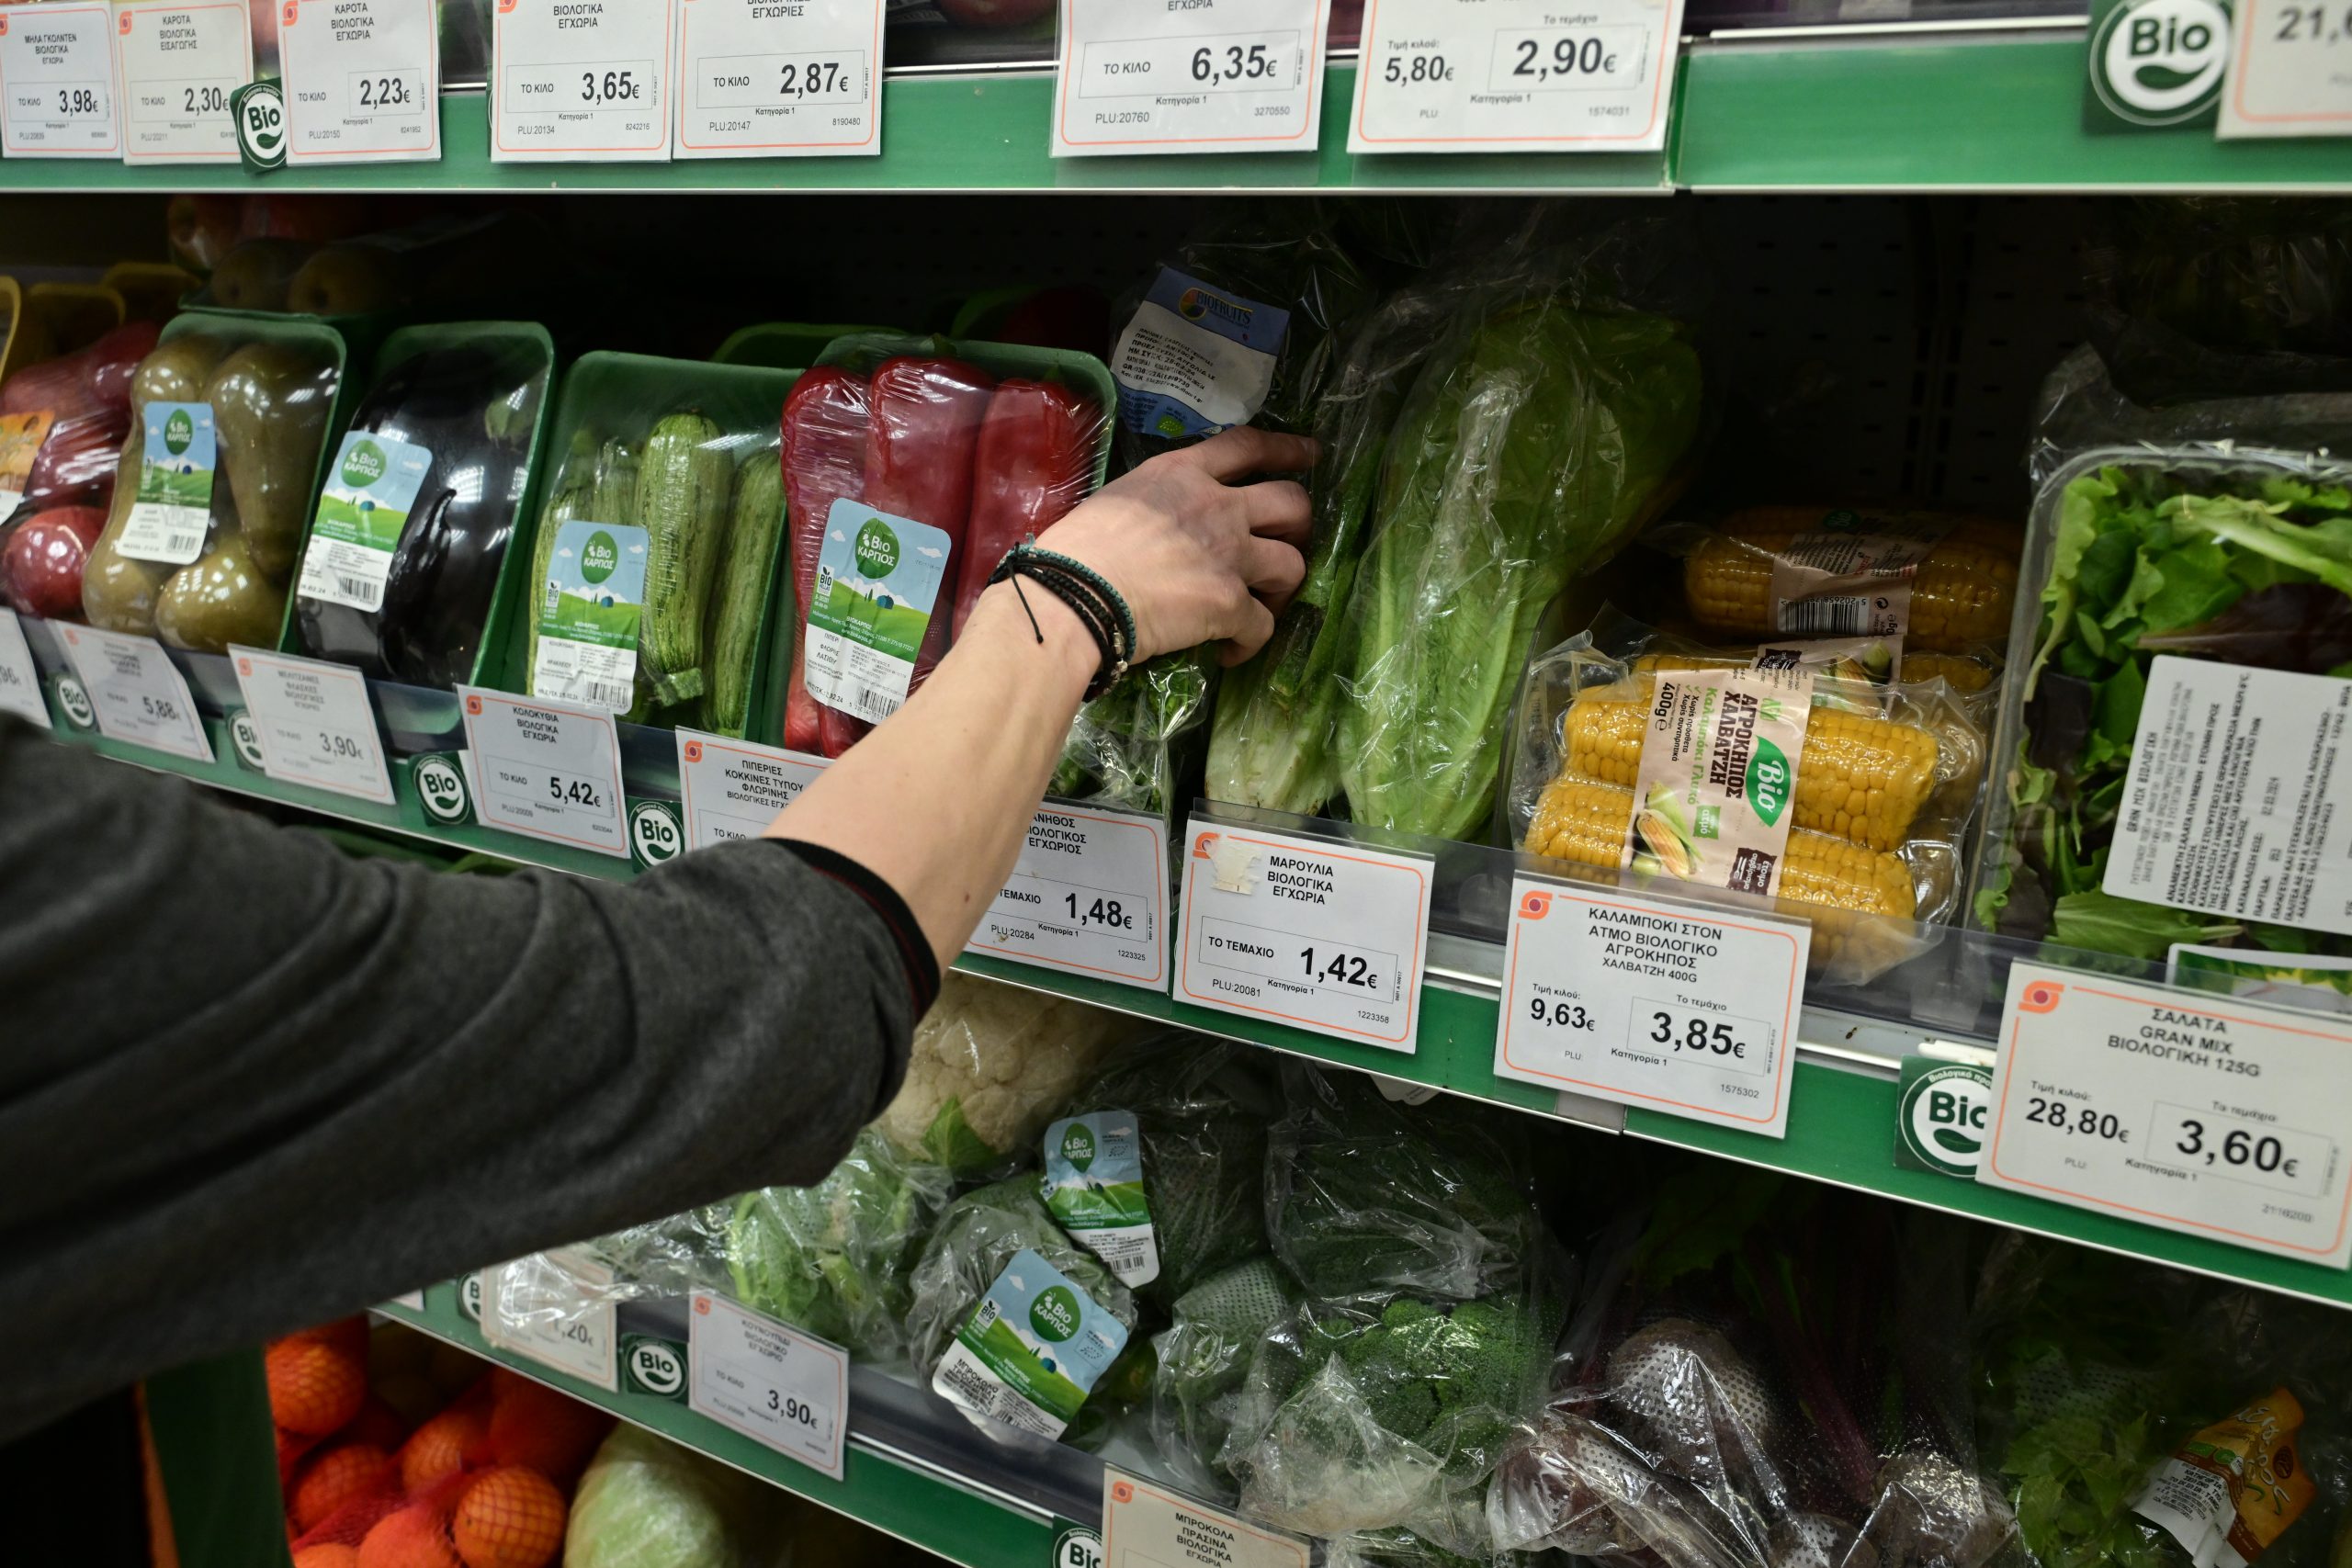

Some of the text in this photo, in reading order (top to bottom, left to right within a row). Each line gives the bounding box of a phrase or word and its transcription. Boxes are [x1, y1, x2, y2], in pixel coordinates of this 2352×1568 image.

[334, 3, 368, 14] ΚΑΡΟΤΑ
[554, 4, 604, 16] ΒΙΟΛΟΓΙΚΑ
[752, 6, 804, 18] ΕΓΧΩΡΙΕΣ
[1168, 0, 1213, 11] ΕΓΧΩΡΙΑ
[162, 15, 191, 25] ΚΑΡΟΤΑ
[331, 17, 374, 28] ΒΙΟΛΟΓΙΚΑ
[559, 17, 598, 28] ΕΓΧΩΡΙΑ
[1543, 15, 1556, 24] Το
[2274, 6, 2352, 47] 21,
[160, 28, 197, 39] ΒΙΟΛΟΓΙΚΑ
[336, 29, 370, 40] ΕΓΧΩΡΙΑ
[2129, 17, 2211, 58] Bio
[36, 45, 69, 54] ΒΙΟΛΟΓΙΚΑ
[161, 40, 198, 51] ΕΙΣΑΓΩΓΗΣ
[1388, 40, 1408, 52] Τιμή
[1103, 62, 1151, 74] ΤΟ ΚΙΛΟ
[1192, 44, 1277, 86] 6,35€
[1513, 39, 1617, 83] 2,90€
[714, 76, 750, 87] ΤΟ ΚΙΛΟ
[780, 62, 848, 99] 2,87€
[1385, 56, 1454, 87] 5,80€
[299, 92, 326, 102] ΤΟ ΚΙΛΟ
[360, 78, 410, 109] 2,23€
[521, 84, 554, 93] ΤΟ ΚΙΛΟ
[582, 72, 639, 105] 3,65€
[59, 90, 98, 117] 3,98€
[141, 96, 165, 106] ΤΟ ΚΙΛΟ
[185, 87, 229, 116] 2,30€
[1156, 96, 1201, 107] Κατηγορία
[1471, 94, 1522, 105] Κατηγορία
[247, 105, 281, 131] Bio
[755, 107, 789, 117] Κατηγορία
[1095, 111, 1149, 124] PLU:20760
[518, 125, 555, 135] PLU:20134
[709, 121, 751, 131] PLU:20147
[1194, 291, 1252, 324] BIOFRUITS
[344, 463, 380, 478] ΚΑΡΠΟΣ
[584, 558, 615, 570] ΚΑΡΠΟΣ
[857, 546, 895, 567] ΚΑΡΠΟΣ
[820, 573, 831, 586] BIO
[62, 687, 85, 705] Bio
[1654, 681, 1675, 717] 400g
[513, 706, 560, 723] ΚΟΛΟΚΥΘΙΑ
[236, 724, 257, 744] Bi
[517, 719, 560, 734] ΒΙΟΛΟΓΙΚΑ
[523, 730, 557, 743] ΕΓΧΩΡΙΑ
[319, 732, 364, 760] 3,90€
[1670, 717, 1686, 761] συντηρητικά
[1687, 686, 1718, 806] Καλαμπόκι Γλυκό
[1708, 690, 1741, 786] ΧΑΛΒΑΤΖΗ
[1724, 693, 1758, 800] ΑΓΡΟΚΗΠΟΣ
[741, 760, 783, 776] ΠΙΠΕΡΙΕΣ
[424, 773, 456, 794] Bio
[725, 769, 803, 792] ΚΟΚΚΙΝΕΣ ΤΥΠΟΥ
[1756, 761, 1785, 814] Bio
[550, 776, 601, 807] 5,42€
[727, 791, 770, 807] ΒΙΟΛΟΓΙΚΕΣ
[741, 784, 788, 800] ΦΛΩΡΙΝΗΣ
[639, 818, 673, 843] Bio
[1701, 808, 1711, 835] ατμό
[714, 828, 725, 837] ΤΟ
[1027, 825, 1087, 844] ΙΟΛΟΓΙΚΟΣ
[1029, 837, 1082, 855] ΕΓΧΩΡΙΟΣ
[1270, 855, 1334, 877] ΜΑΡΟΥΛΙΑ
[1743, 852, 1758, 890] σερβίρισμα
[1757, 860, 1770, 886] έτοιμο
[1267, 871, 1333, 893] ΒΙΟΛΟΓΙΚΑ
[1273, 886, 1326, 905] ΕΓΧΩΡΙΑ
[1065, 892, 1133, 930] 1,48€
[990, 924, 1035, 941] PLU:20284
[1038, 923, 1073, 937] Κατηγορία
[1589, 908, 1722, 940] ΚΑΛΑΜΠΟΚΙ ΣΤΟΝ
[1208, 936, 1274, 958] ΤΟ ΤΕΜΑΧΙΟ
[1589, 925, 1718, 957] ΑΤΜΟ ΒΙΟΛΟΓΙΚΟ
[1117, 949, 1147, 961] 1223325
[1605, 942, 1698, 969] ΑΓΡΟΚΗΠΟΣ
[1300, 947, 1378, 989] 1,42€
[1602, 958, 1698, 984] ΧΑΛΒΑΤΖΗ 400G
[1212, 978, 1261, 998] PLU:20081
[1268, 978, 1315, 996] Κατηγορία 1
[1532, 983, 1581, 1000] Τιμή κιλού:
[1677, 994, 1727, 1012] Το τεμάχιο
[1358, 1010, 1390, 1024] 1223358
[1531, 998, 1595, 1032] 9,63€
[2153, 1008, 2227, 1034] ΣΑΛΑΤΑ
[1650, 1011, 1747, 1059] 3,85€
[2140, 1025, 2234, 1055] GRAN MIX
[1611, 1047, 1668, 1066] Κατηγορία 1
[2108, 1035, 2261, 1077] ΒΙΟΛΟΓΙΚΗ 125G
[1928, 1071, 1973, 1083] Βιολογικό
[1720, 1083, 1759, 1100] 1575302
[2030, 1079, 2093, 1102] Τιμή κιλού:
[2212, 1100, 2228, 1113] Το
[2026, 1097, 2130, 1144] 28,80€
[2177, 1118, 2300, 1179] 3,60€
[2125, 1156, 2198, 1182] Κατηγορία 1
[979, 1304, 997, 1320] BIO
[1034, 1303, 1072, 1338] ΚΑΡΠΟΣ
[639, 1352, 673, 1374] Bio
[768, 1389, 818, 1430] 3,90€
[1175, 1513, 1235, 1542] ΜΠΡΟΚΟΛΑ
[1177, 1535, 1232, 1563] ΒΙΟΛΟΓΙΚΑ
[1182, 1527, 1227, 1551] ΠΡΑΣΙΝΑ
[1186, 1550, 1222, 1568] ΕΓΧΩΡΙΑ
